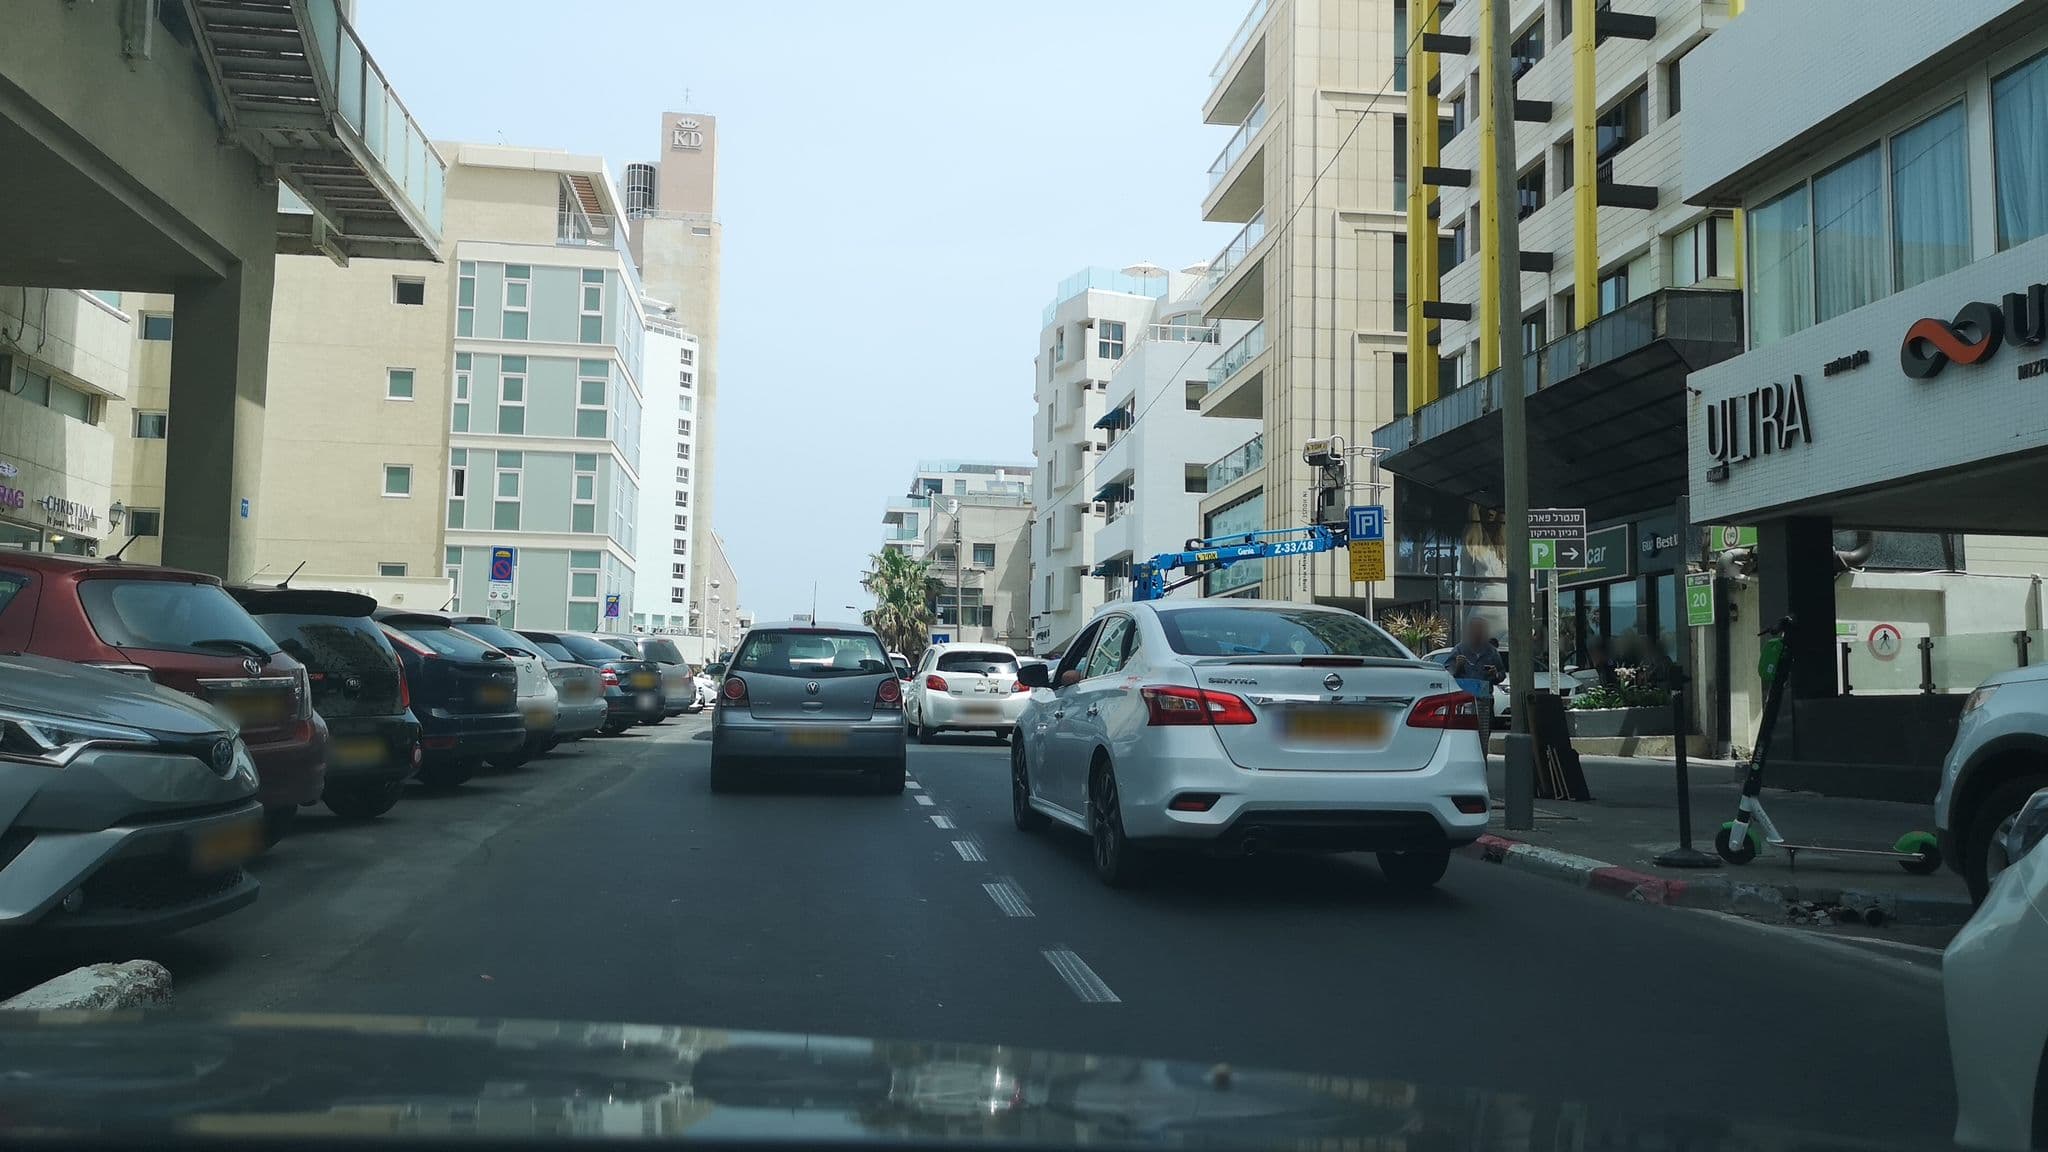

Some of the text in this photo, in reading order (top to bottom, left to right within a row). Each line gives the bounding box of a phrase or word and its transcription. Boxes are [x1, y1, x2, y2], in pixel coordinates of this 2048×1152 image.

[673, 129, 703, 147] KD
[1706, 374, 1812, 464] ULTRA
[46, 496, 95, 520] CHRISTINA
[1274, 541, 1314, 553] Z-33/18
[1532, 543, 1549, 565] P
[1693, 592, 1707, 607] 20
[1208, 677, 1258, 685] SENTRA
